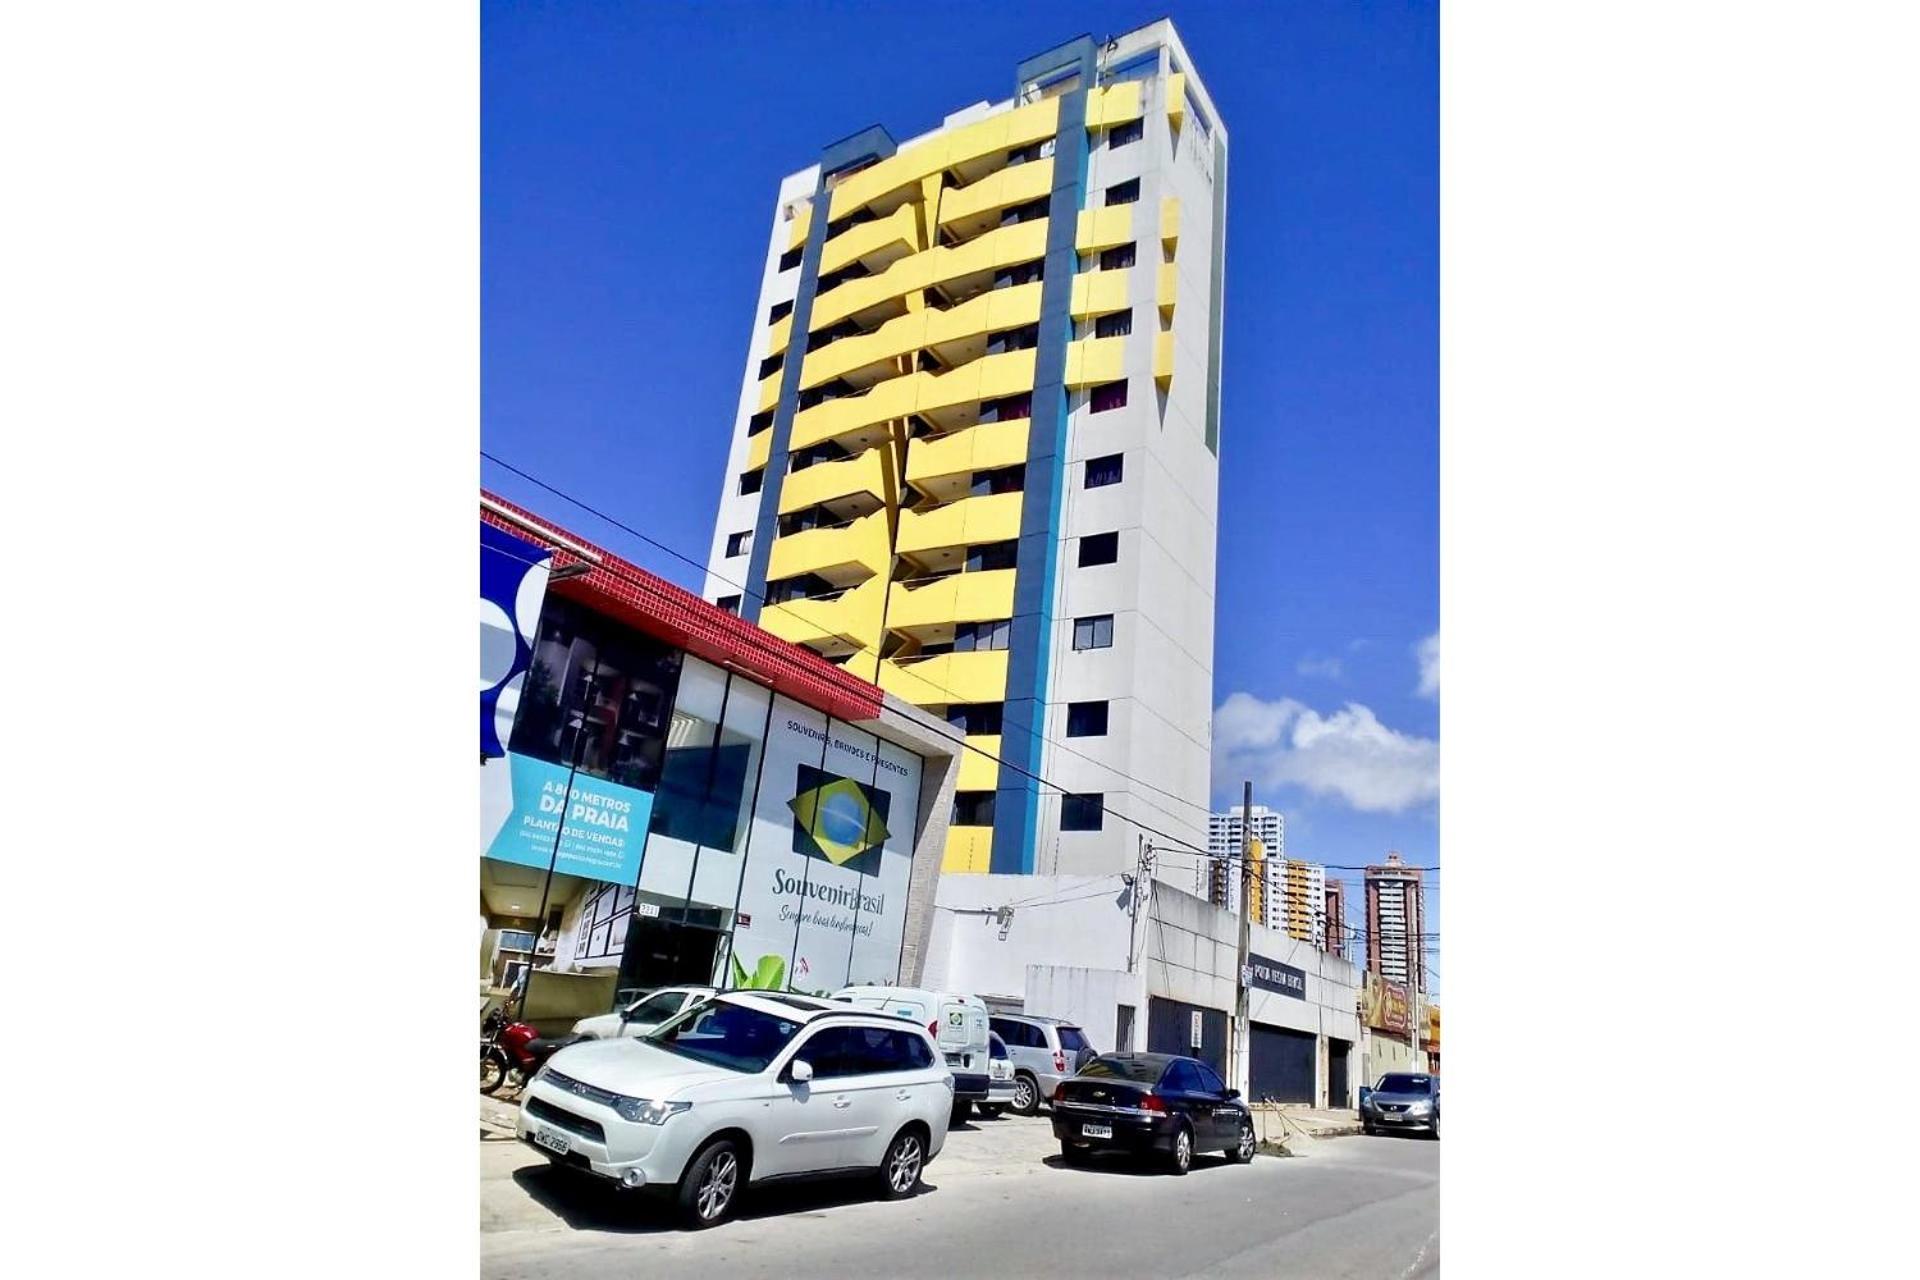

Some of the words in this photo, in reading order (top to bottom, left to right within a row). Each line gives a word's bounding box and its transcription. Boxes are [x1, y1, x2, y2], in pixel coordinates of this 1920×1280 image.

[539, 794, 568, 819] DA
[572, 803, 629, 833] PRAIA
[543, 781, 553, 793] A
[581, 792, 632, 814] METROS
[571, 828, 586, 840] DE
[586, 831, 625, 848] VENDAS
